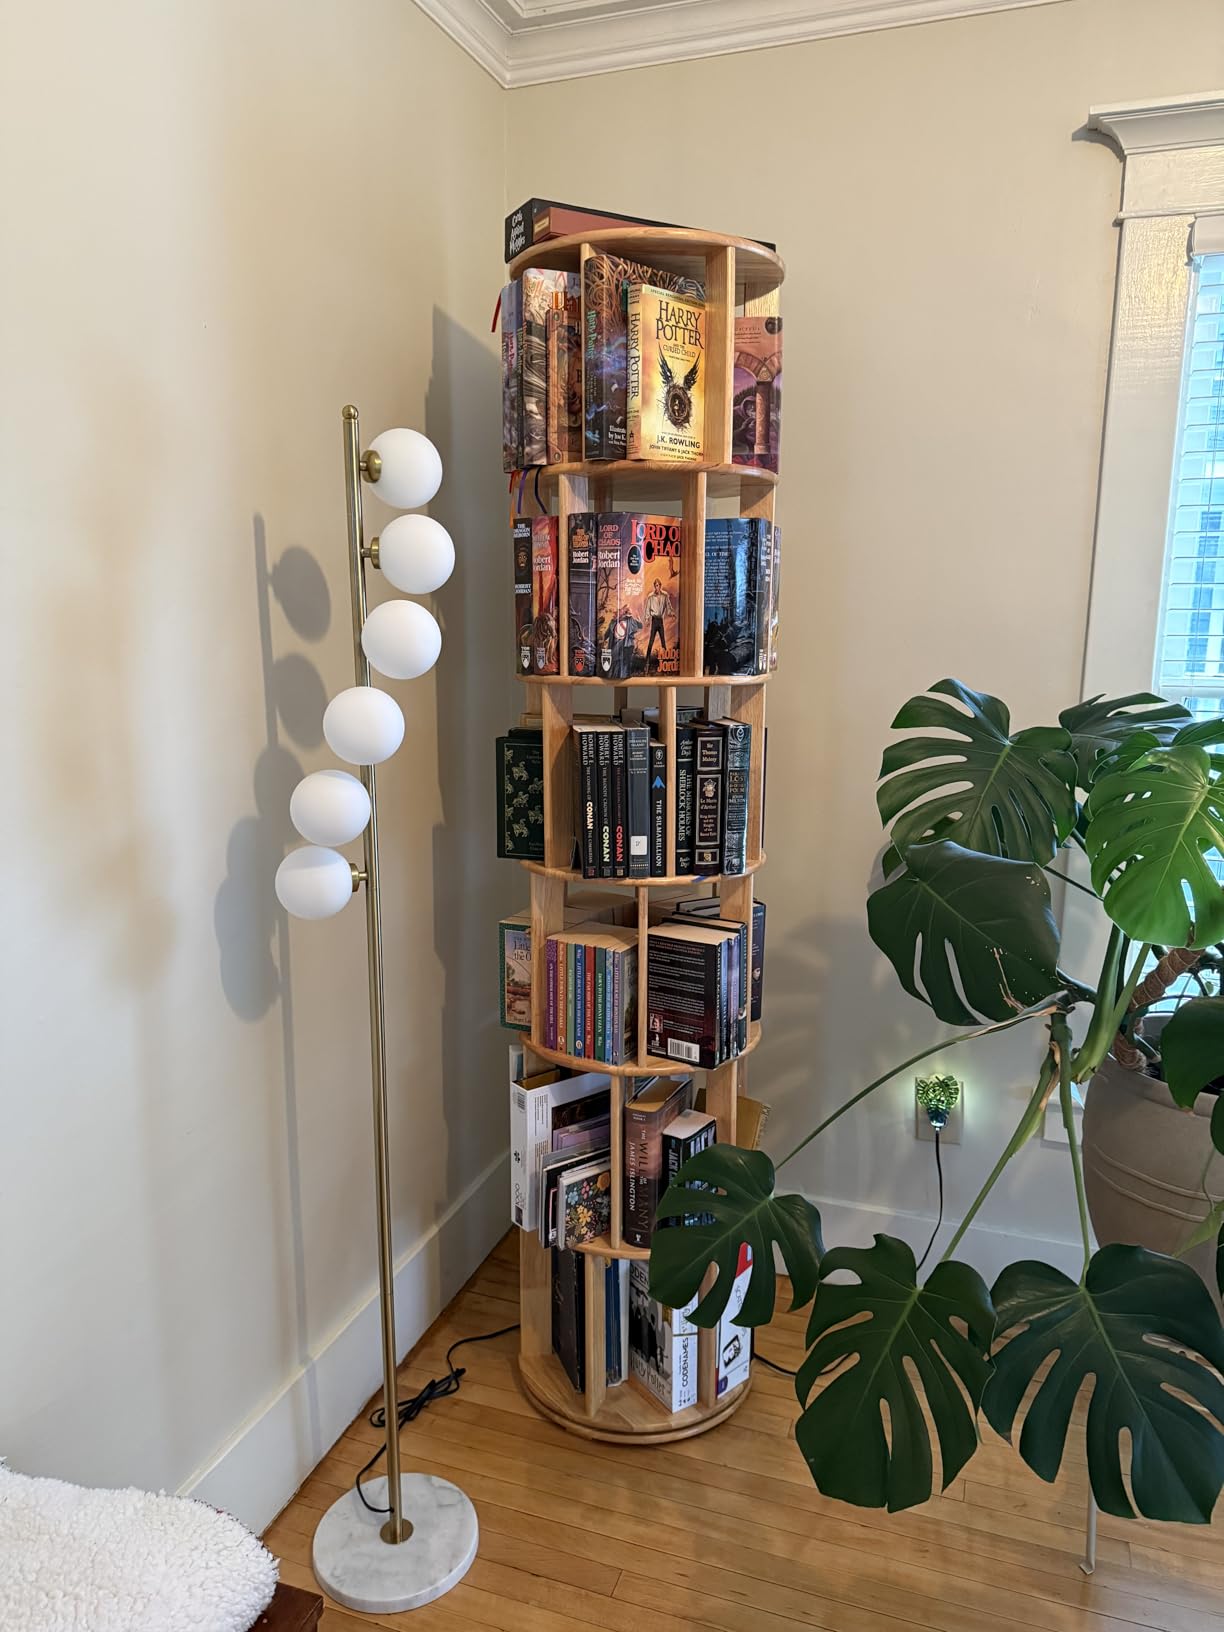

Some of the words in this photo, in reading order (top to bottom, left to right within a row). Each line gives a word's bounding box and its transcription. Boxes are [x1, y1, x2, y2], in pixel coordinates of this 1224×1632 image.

[510, 234, 526, 256] Muggles
[587, 310, 597, 332] Harry
[658, 300, 702, 330] HARRY
[630, 312, 640, 352] HARRY
[656, 318, 704, 350] POTTER
[587, 332, 597, 359] Potter
[630, 354, 640, 400] POTTER
[657, 435, 668, 444] J.K.
[669, 437, 700, 448] ROWLING
[631, 520, 666, 544] LORD
[668, 526, 680, 541] O
[598, 550, 620, 560] Robert
[643, 540, 680, 562] CHAO
[598, 560, 620, 568] Jordan
[658, 649, 679, 659] Robe
[657, 660, 679, 672] Jord
[690, 1126, 715, 1158] JACK
[639, 1142, 648, 1172] WILL
[669, 1149, 678, 1170] JACK
[639, 1186, 648, 1228] MANY
